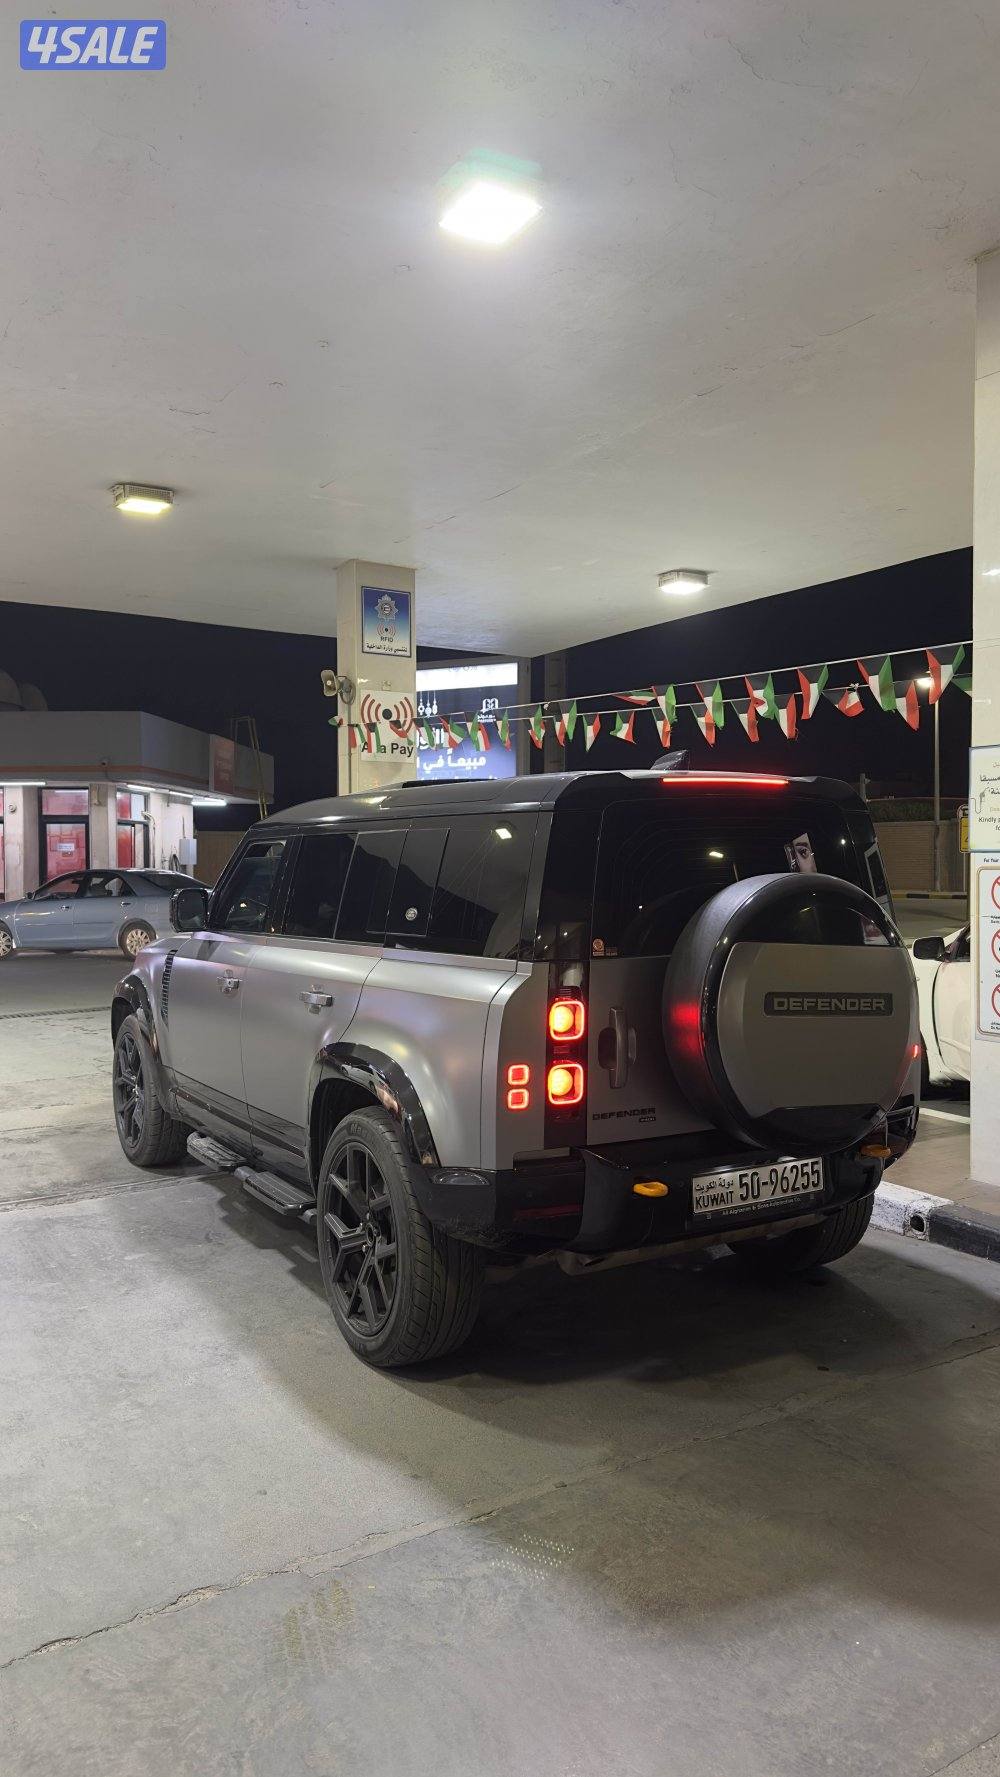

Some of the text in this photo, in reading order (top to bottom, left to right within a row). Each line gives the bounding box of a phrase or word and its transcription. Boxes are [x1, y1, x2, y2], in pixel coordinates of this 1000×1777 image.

[390, 742, 414, 758] Pay
[422, 755, 445, 774] في
[978, 817, 997, 825] Kindly
[773, 997, 886, 1011] DEFENDER
[592, 1107, 656, 1120] DEFENDER
[695, 1177, 734, 1193] دولة الكويت
[738, 1160, 820, 1201] 50-96255
[695, 1190, 734, 1209] KUWAIT
